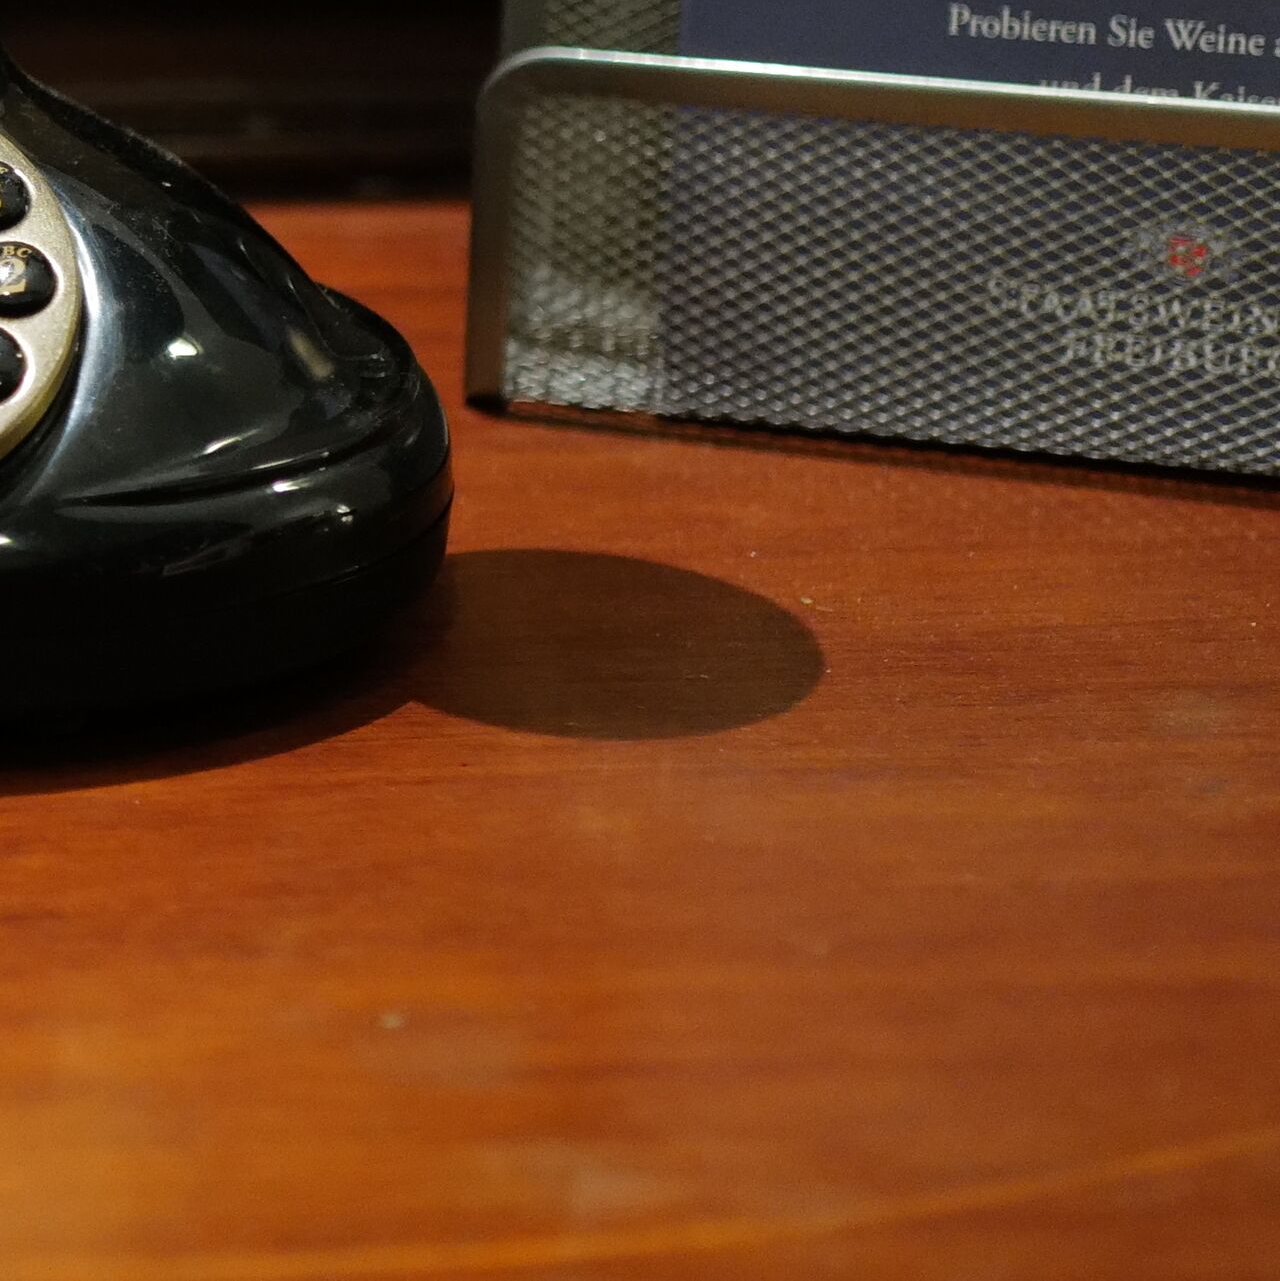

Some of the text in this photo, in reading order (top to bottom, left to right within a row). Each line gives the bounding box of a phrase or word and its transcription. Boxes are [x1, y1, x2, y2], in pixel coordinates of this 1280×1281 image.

[948, 1, 1266, 58] Probieren Sie Weine
